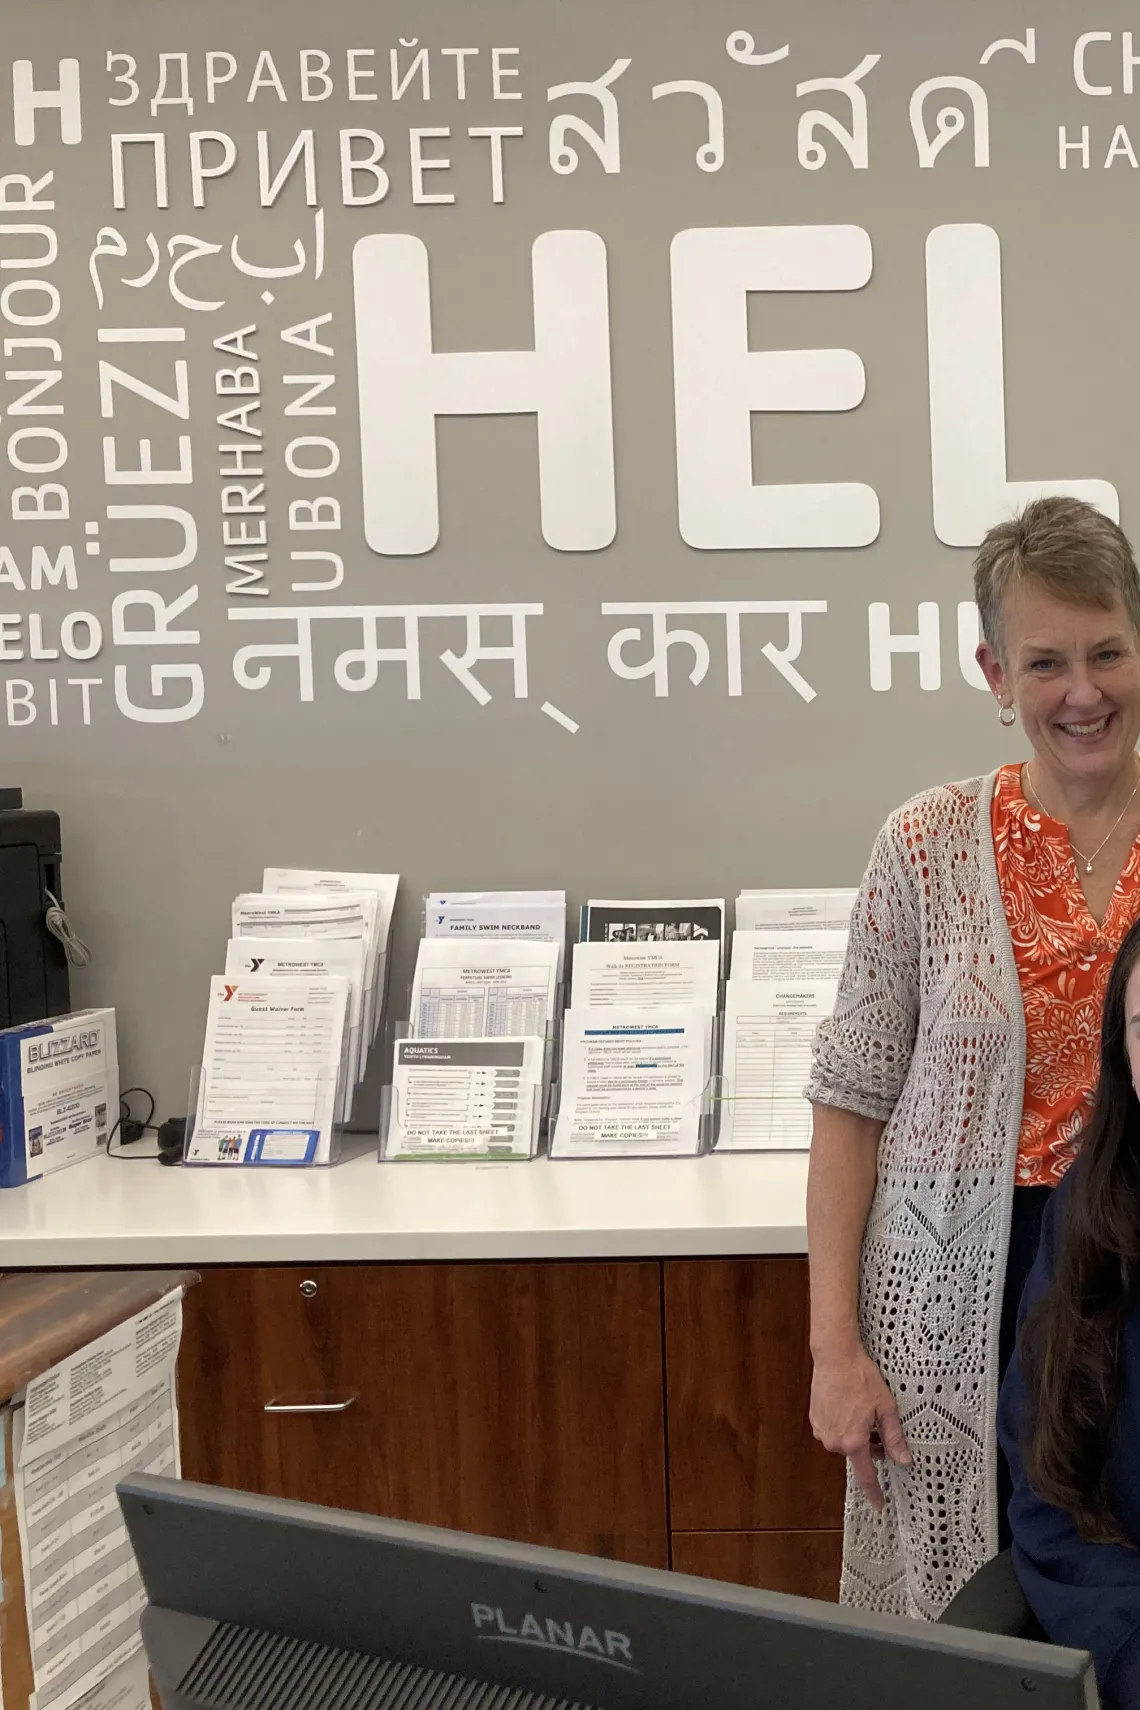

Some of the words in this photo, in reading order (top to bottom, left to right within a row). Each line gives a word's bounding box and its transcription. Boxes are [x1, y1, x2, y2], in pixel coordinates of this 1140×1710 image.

[107, 38, 522, 116] ЗДРАВЕЙТЕ
[110, 127, 523, 208] ПРИВЕТ
[0, 170, 70, 520] BONJOUR
[213, 323, 270, 595] MERHABA
[281, 312, 344, 592] UBONA
[85, 327, 205, 723] GRÜEZI
[27, 1062, 54, 1074] BLINDING
[54, 1057, 70, 1067] WHITE
[70, 1053, 85, 1062] COPY
[85, 1049, 102, 1058] PAPER
[28, 1030, 98, 1064] BLIZZARD
[404, 1046, 439, 1055] AQUATICS
[470, 1602, 633, 1661] PLANAR
